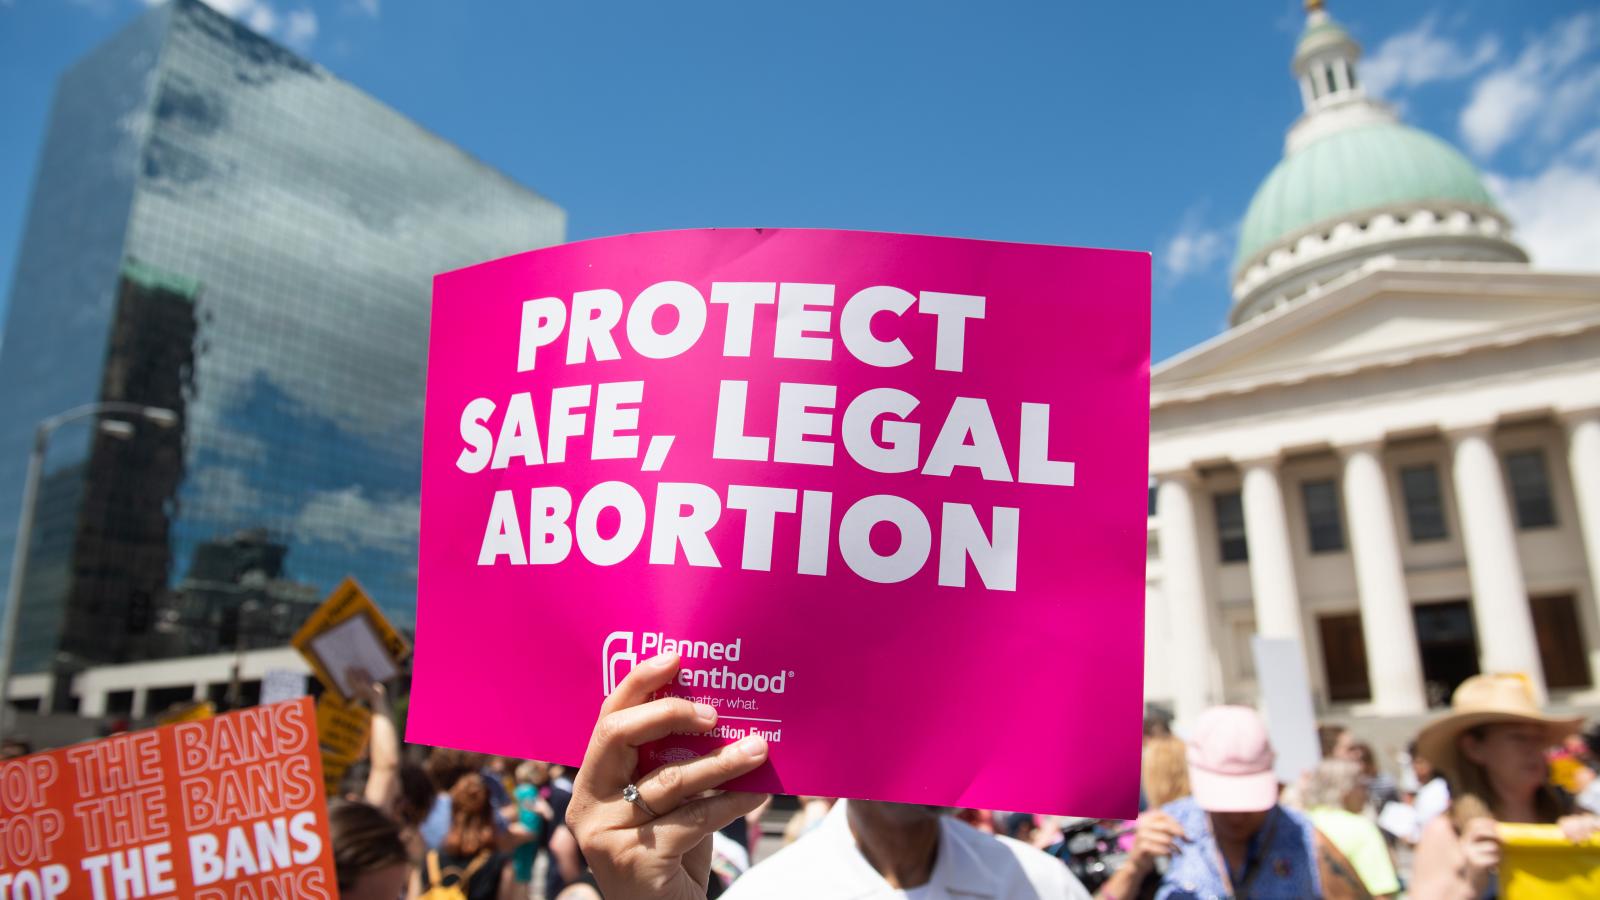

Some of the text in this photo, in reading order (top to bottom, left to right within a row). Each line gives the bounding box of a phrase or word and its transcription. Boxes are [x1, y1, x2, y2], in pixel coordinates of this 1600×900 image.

[517, 280, 986, 373] PROTECT
[456, 379, 1075, 487] SAFE, LEGAL
[477, 481, 1020, 592] ABORTION
[642, 632, 741, 662] Planned
[726, 697, 759, 711] what.
[750, 726, 782, 743] Fund
[0, 755, 59, 814] OP
[67, 731, 165, 798] THE
[174, 701, 309, 777] BANS
[74, 786, 171, 852] THE
[181, 755, 316, 831] BANS
[81, 841, 176, 900] THE
[187, 812, 323, 887] BANS
